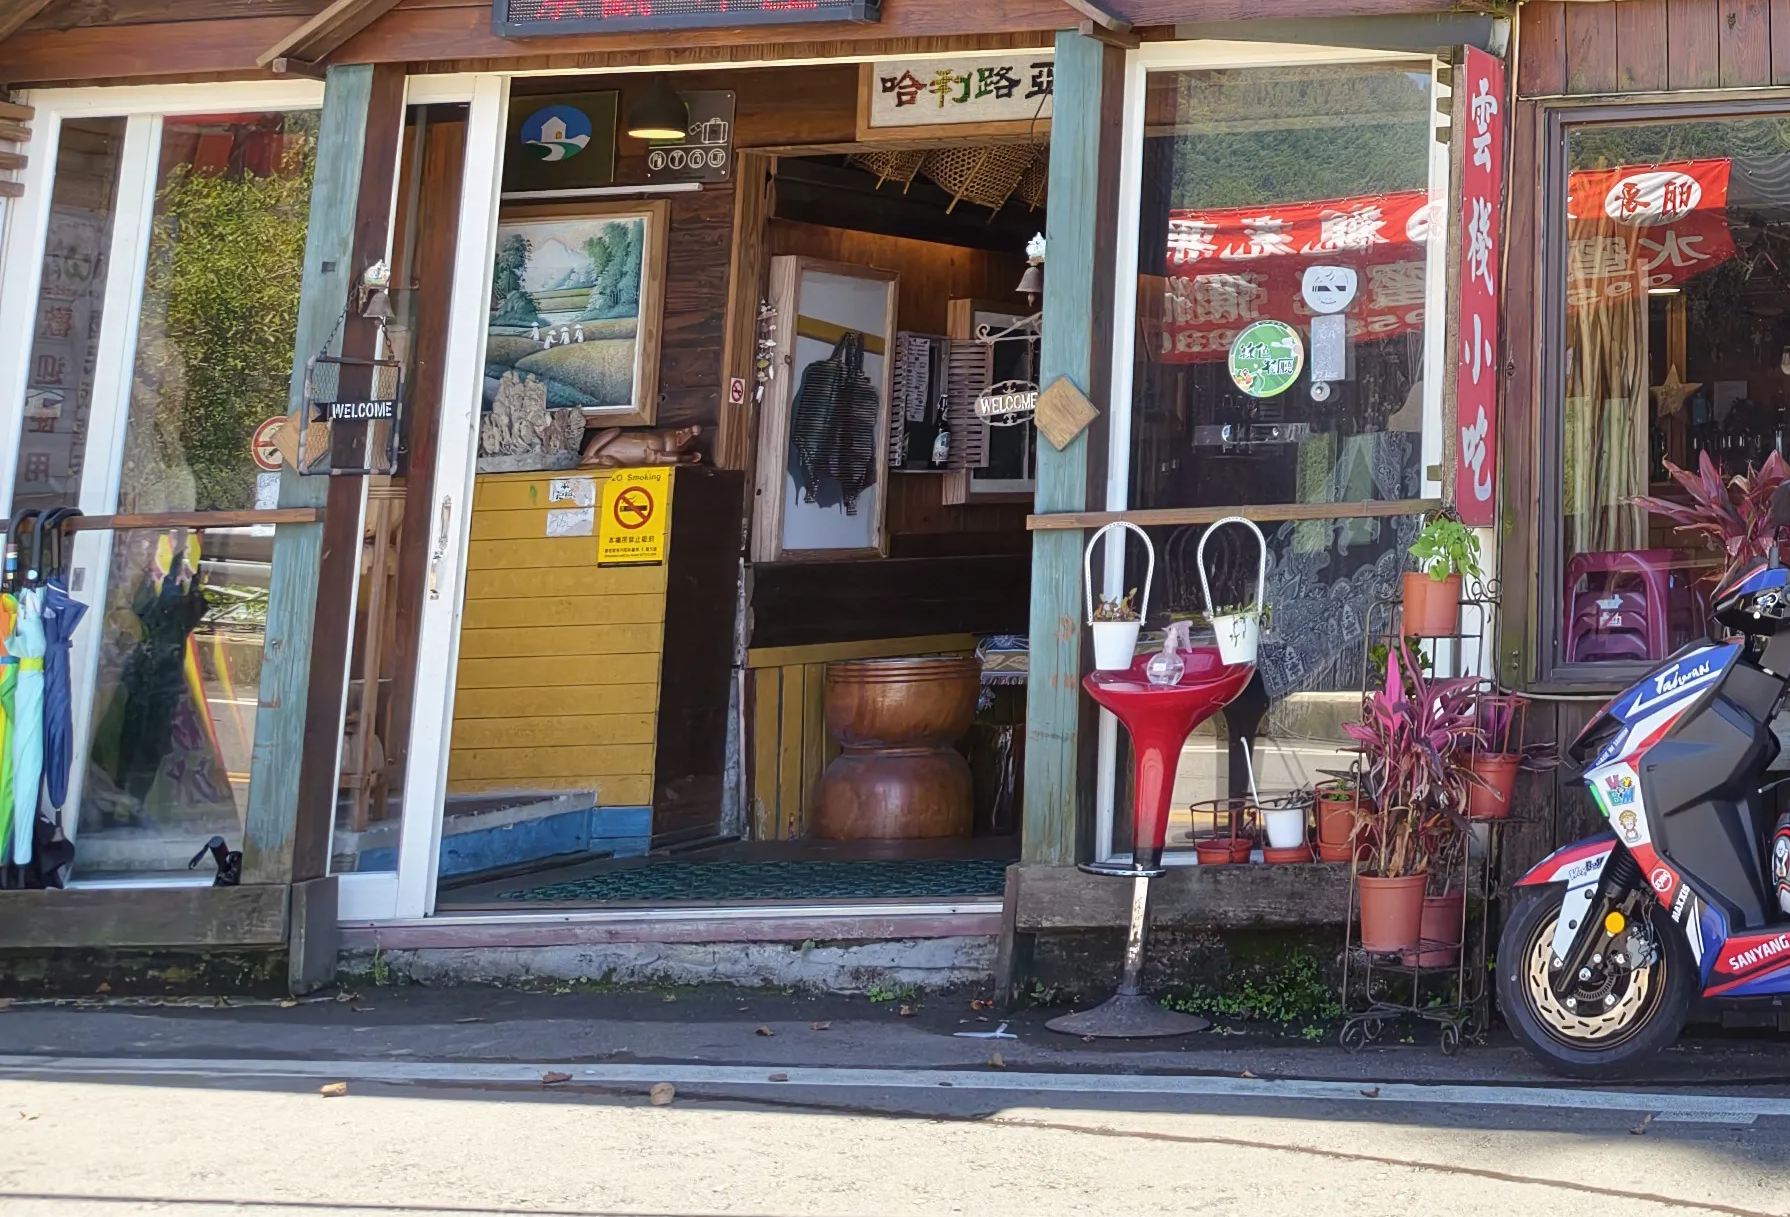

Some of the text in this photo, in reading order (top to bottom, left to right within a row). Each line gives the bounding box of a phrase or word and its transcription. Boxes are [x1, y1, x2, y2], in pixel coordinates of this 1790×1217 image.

[332, 401, 393, 419] WELCOME
[979, 392, 1038, 414] WELCOME
[627, 473, 662, 482] Smoking
[1671, 883, 1691, 924] MAXXIS
[1728, 934, 1790, 971] SANYANG
